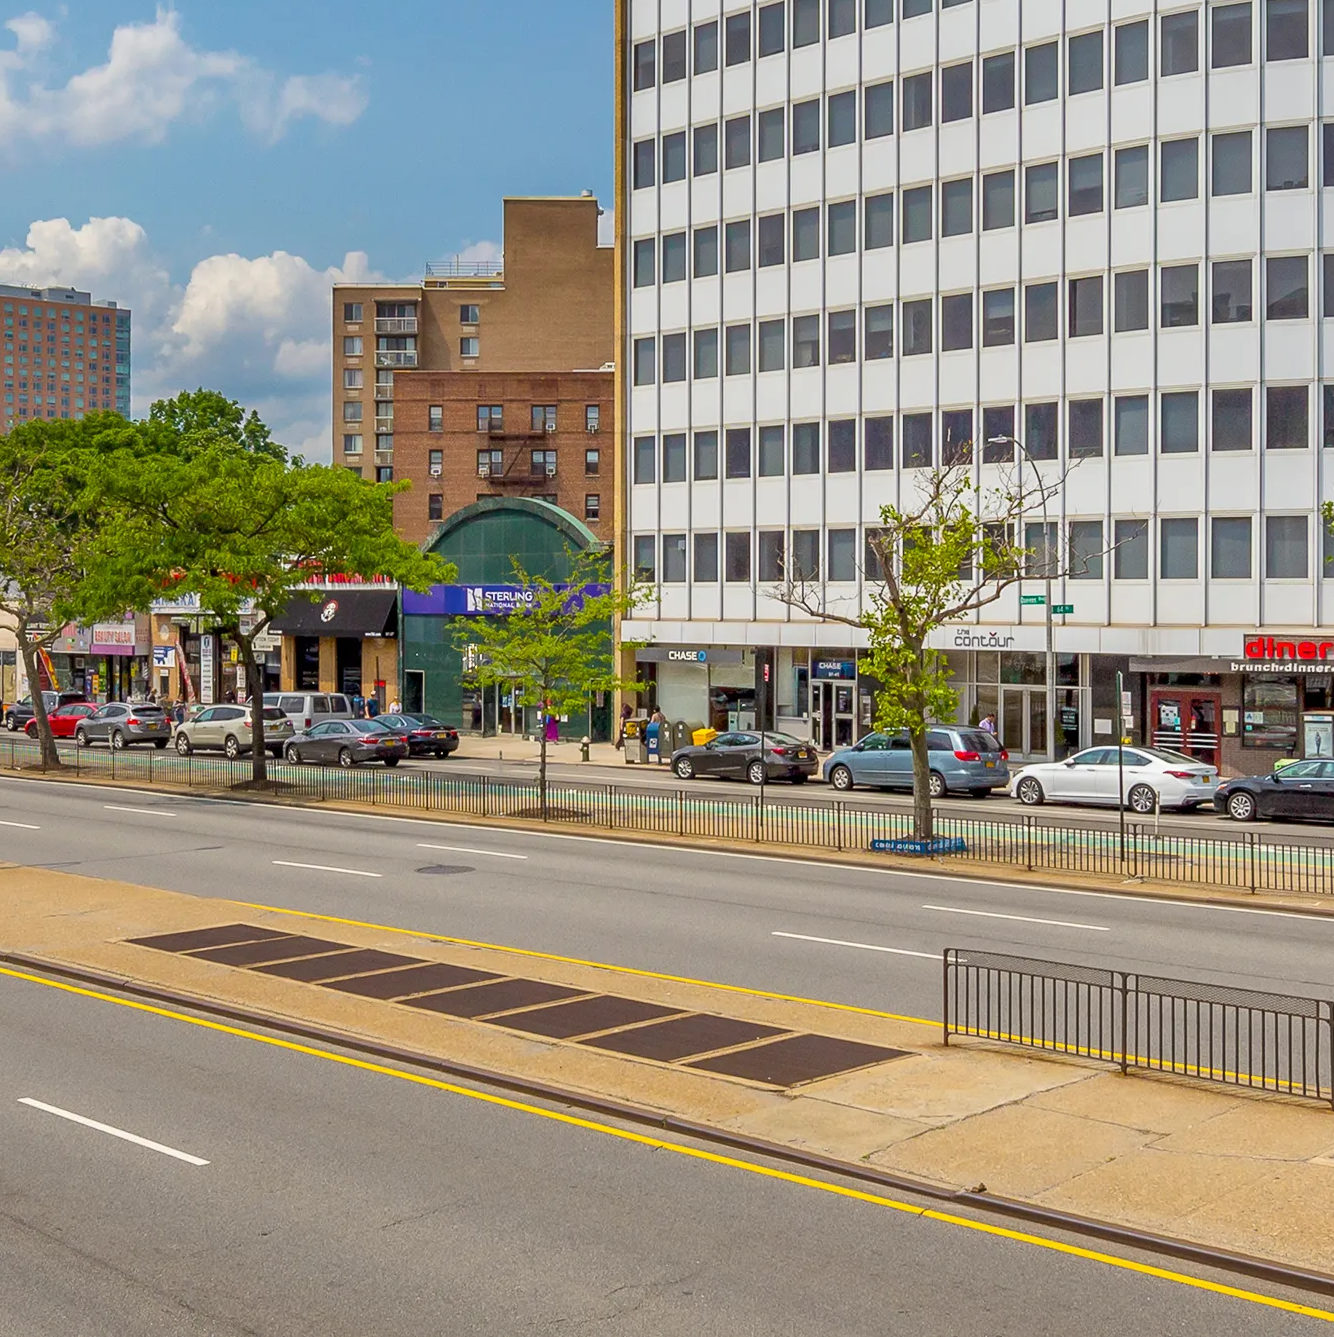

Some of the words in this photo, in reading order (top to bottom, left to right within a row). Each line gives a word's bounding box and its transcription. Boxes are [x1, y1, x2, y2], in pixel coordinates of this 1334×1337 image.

[485, 591, 533, 602] STERLING
[94, 630, 114, 642] BEAUTY
[114, 630, 131, 643] SALON
[668, 650, 698, 661] CHASE
[818, 662, 841, 670] CHASE
[1230, 662, 1280, 672] brunch
[1284, 663, 1331, 674] dinner
